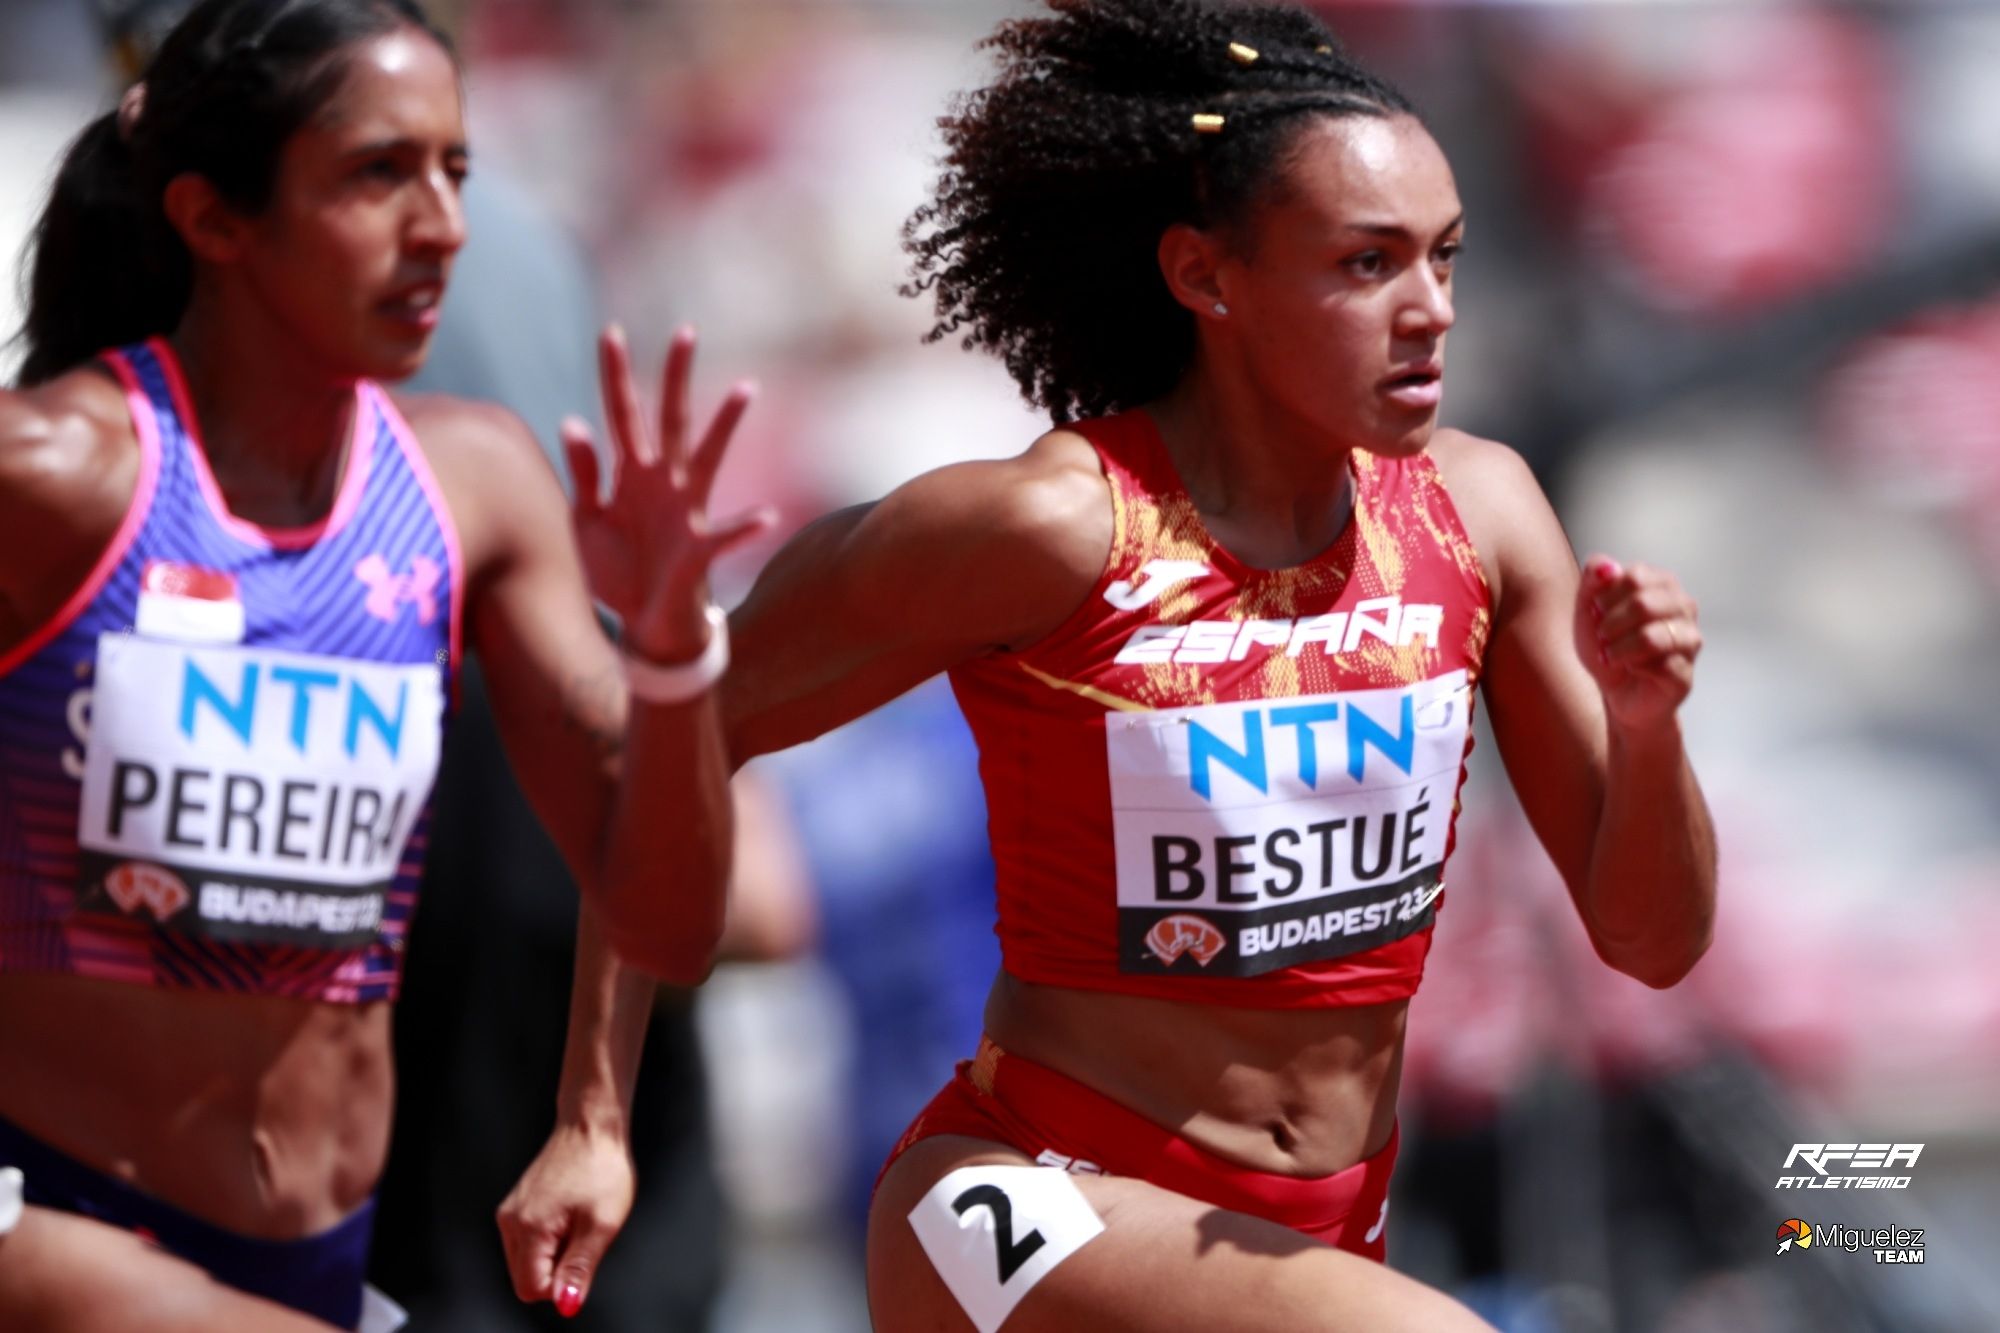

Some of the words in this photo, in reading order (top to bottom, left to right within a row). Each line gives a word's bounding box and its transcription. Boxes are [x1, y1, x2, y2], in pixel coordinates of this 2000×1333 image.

[1114, 597, 1443, 664] ESPAÑA
[180, 657, 408, 761] NTN
[1187, 694, 1415, 800] NTN
[1152, 785, 1431, 904] BESTUÉ
[1239, 898, 1397, 957] BUDAPEST
[951, 1184, 1046, 1286] 2
